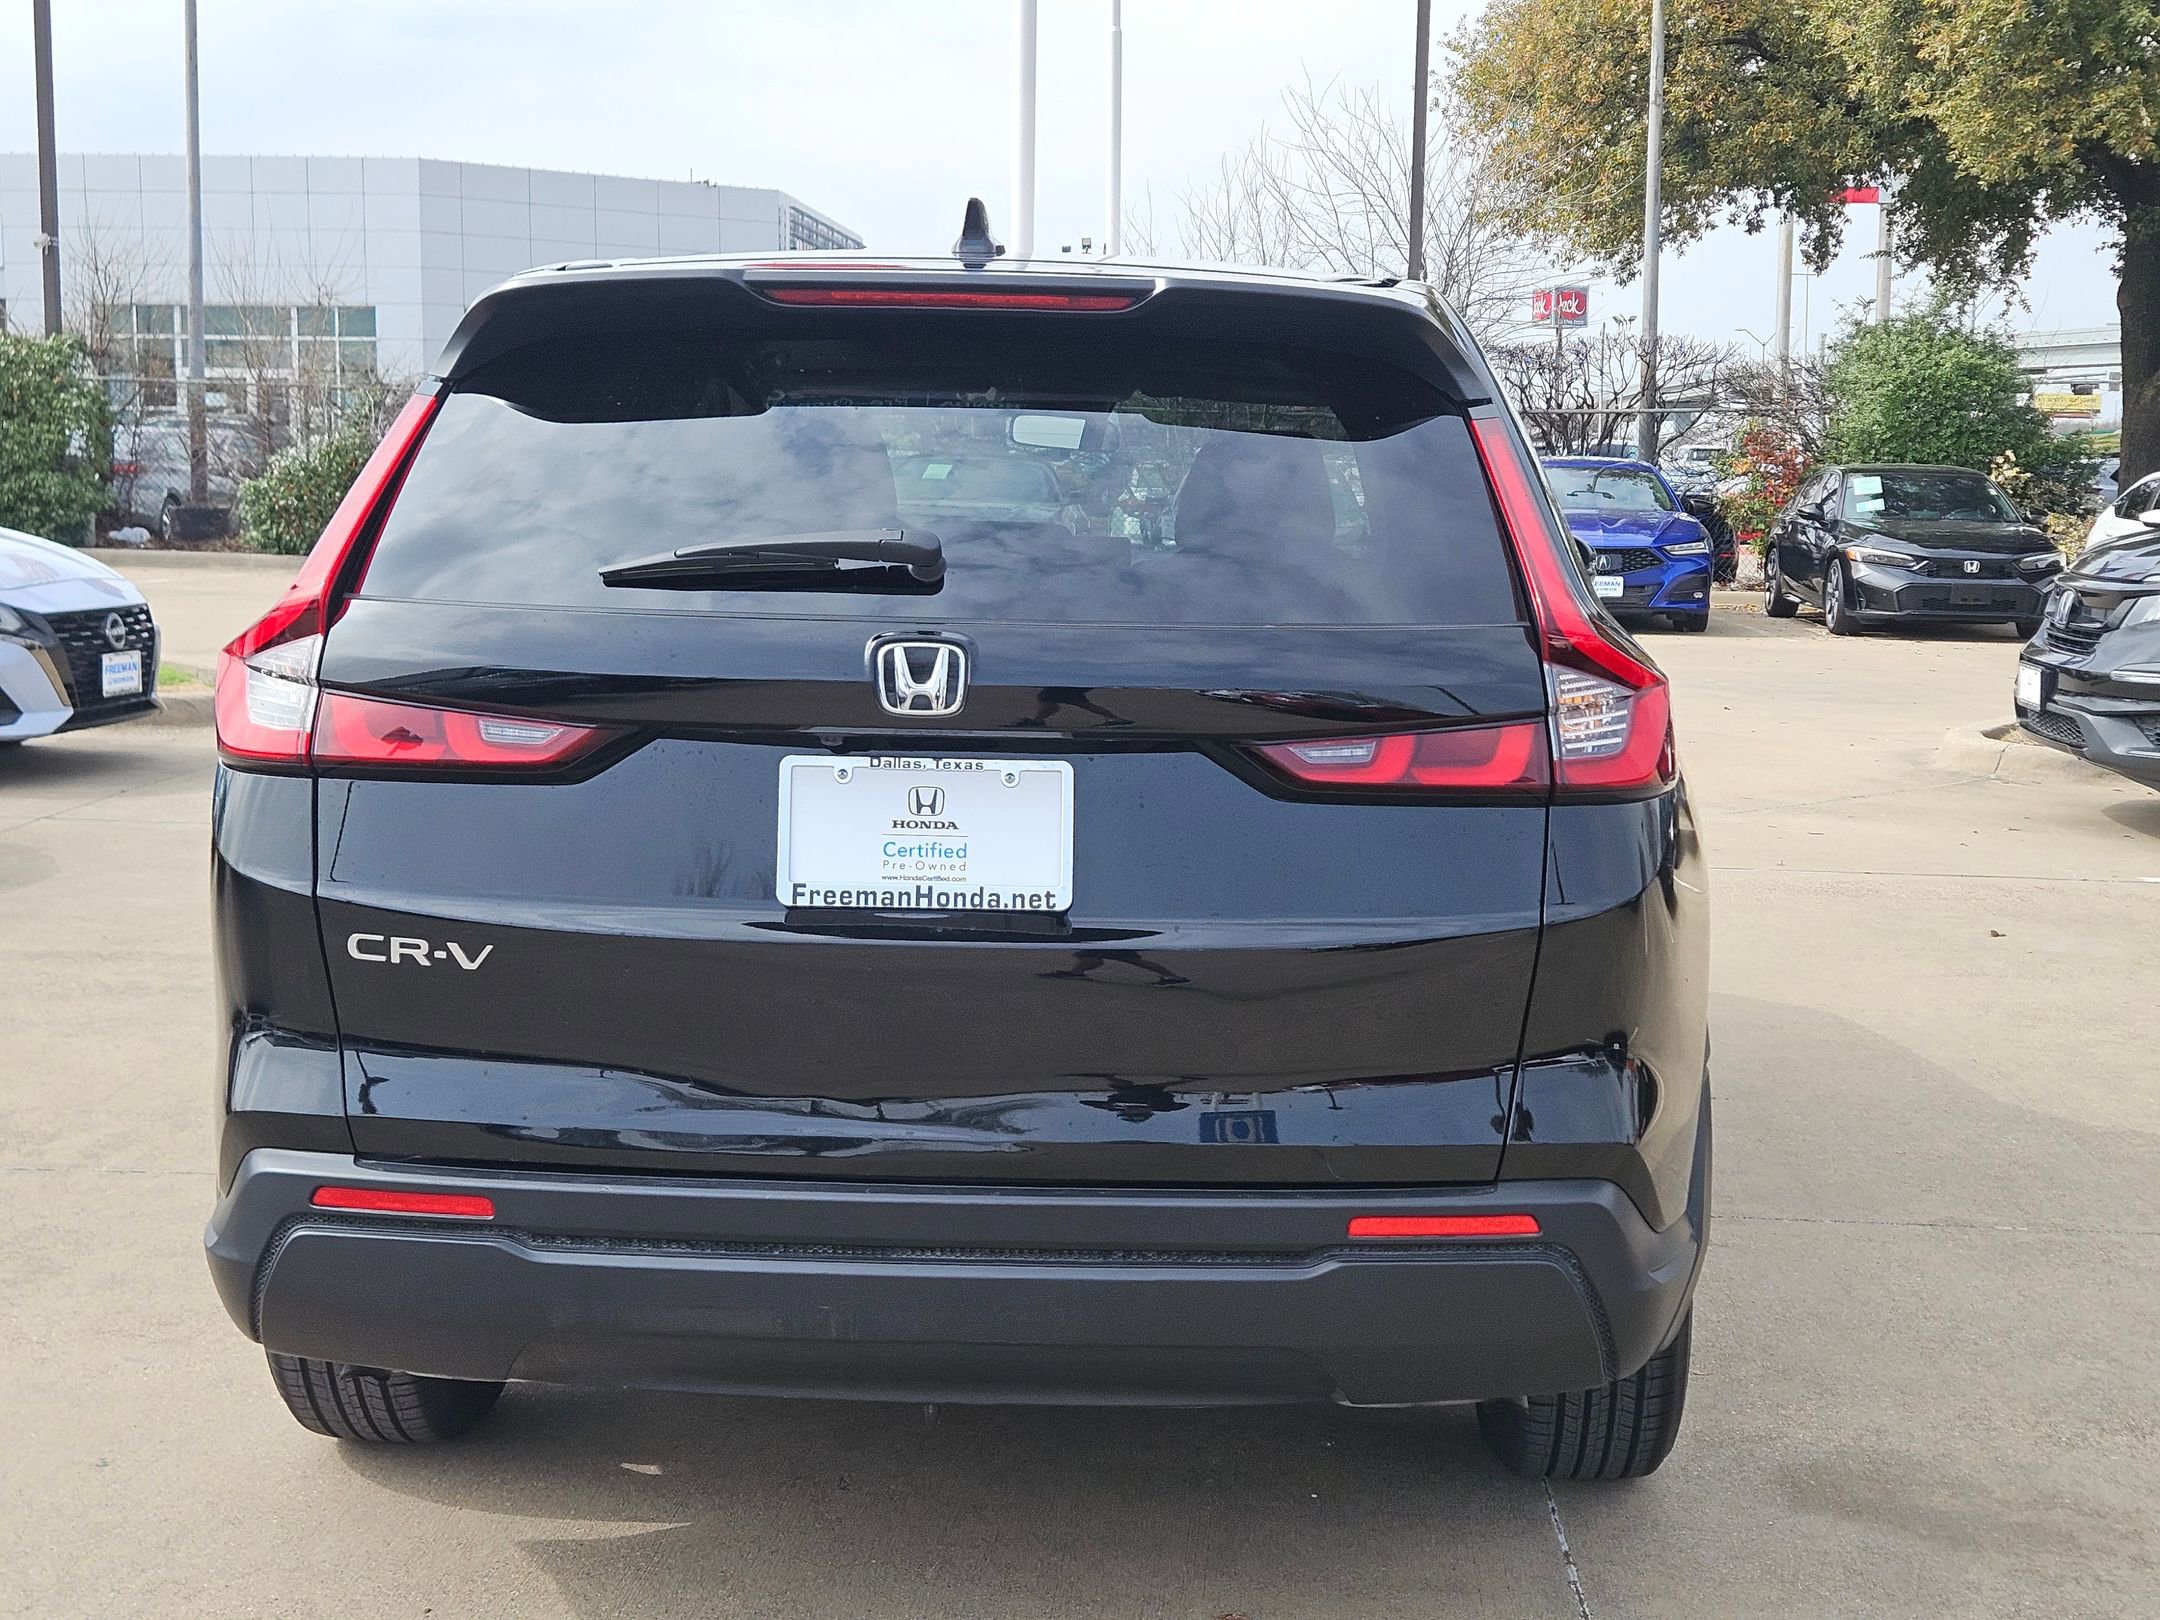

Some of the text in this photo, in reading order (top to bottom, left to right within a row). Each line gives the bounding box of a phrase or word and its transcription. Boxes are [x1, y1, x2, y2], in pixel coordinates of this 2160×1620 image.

[105, 661, 137, 674] FREEMAN
[869, 757, 985, 771] Dallas, Texas
[892, 819, 960, 830] HONDA
[883, 841, 967, 859] Certified
[882, 859, 967, 872] Pre-Owned
[791, 882, 1057, 911] FreemanHonda.net
[347, 933, 495, 970] CR-V
